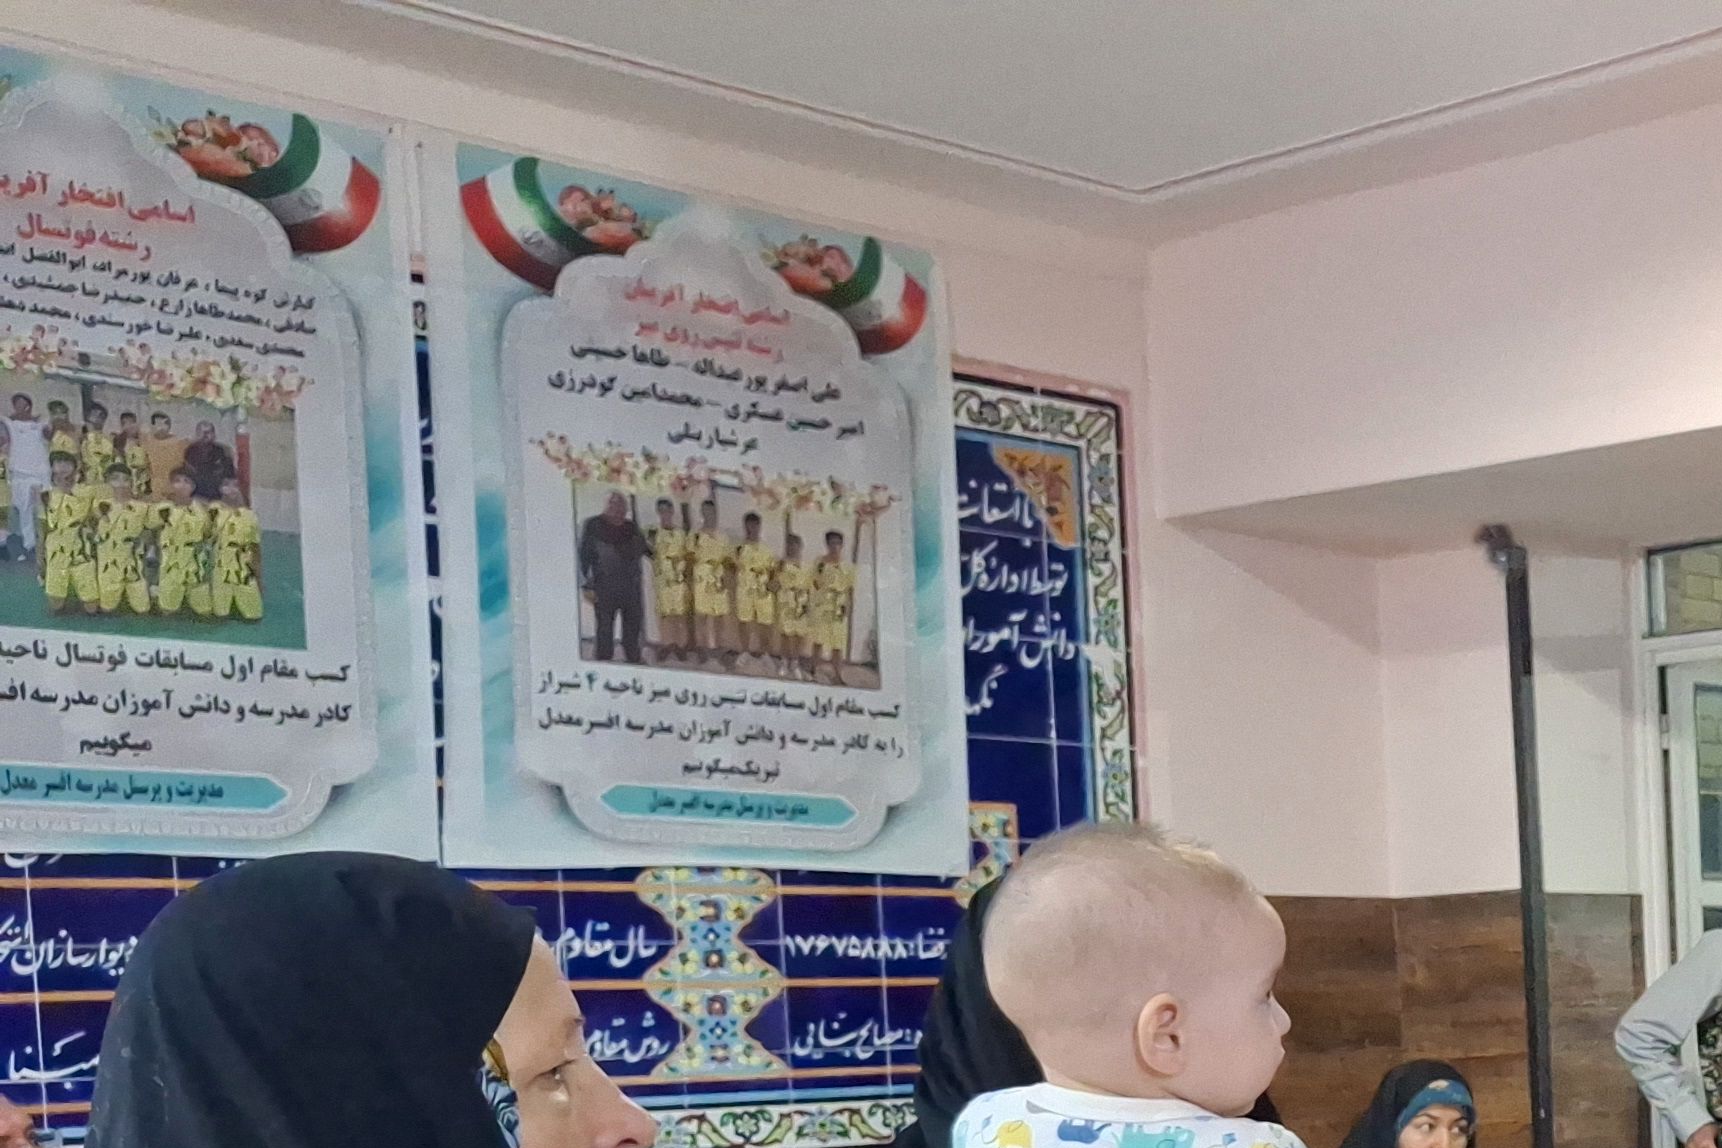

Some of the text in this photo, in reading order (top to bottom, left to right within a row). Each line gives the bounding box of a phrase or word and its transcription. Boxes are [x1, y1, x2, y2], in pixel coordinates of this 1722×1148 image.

[17, 212, 151, 261] رشته فوتسال
[1029, 562, 1069, 597] توسط
[1019, 611, 1076, 669] دانش
[0, 639, 352, 688] کسب مقام اول مسابقات فوتسال ناحی
[538, 669, 582, 694] شیراز
[602, 677, 644, 699] ناحیه
[30, 686, 99, 712] مدرسه
[102, 688, 174, 717] آموزان
[177, 693, 232, 719] دانش
[674, 688, 707, 708] روی
[750, 690, 806, 714] مسابقات
[808, 696, 833, 719] اول
[835, 696, 866, 717] مقام
[234, 703, 246, 724] و
[248, 699, 311, 726] مدرسه
[313, 703, 352, 729] کادر
[868, 704, 901, 720] کسب
[625, 717, 675, 740] مدرسه
[790, 732, 836, 752] مدرسه
[842, 733, 870, 755] کادر
[75, 777, 120, 800] مدرسه
[623, 1010, 671, 1063] روش
[854, 1017, 904, 1060] مصالح
